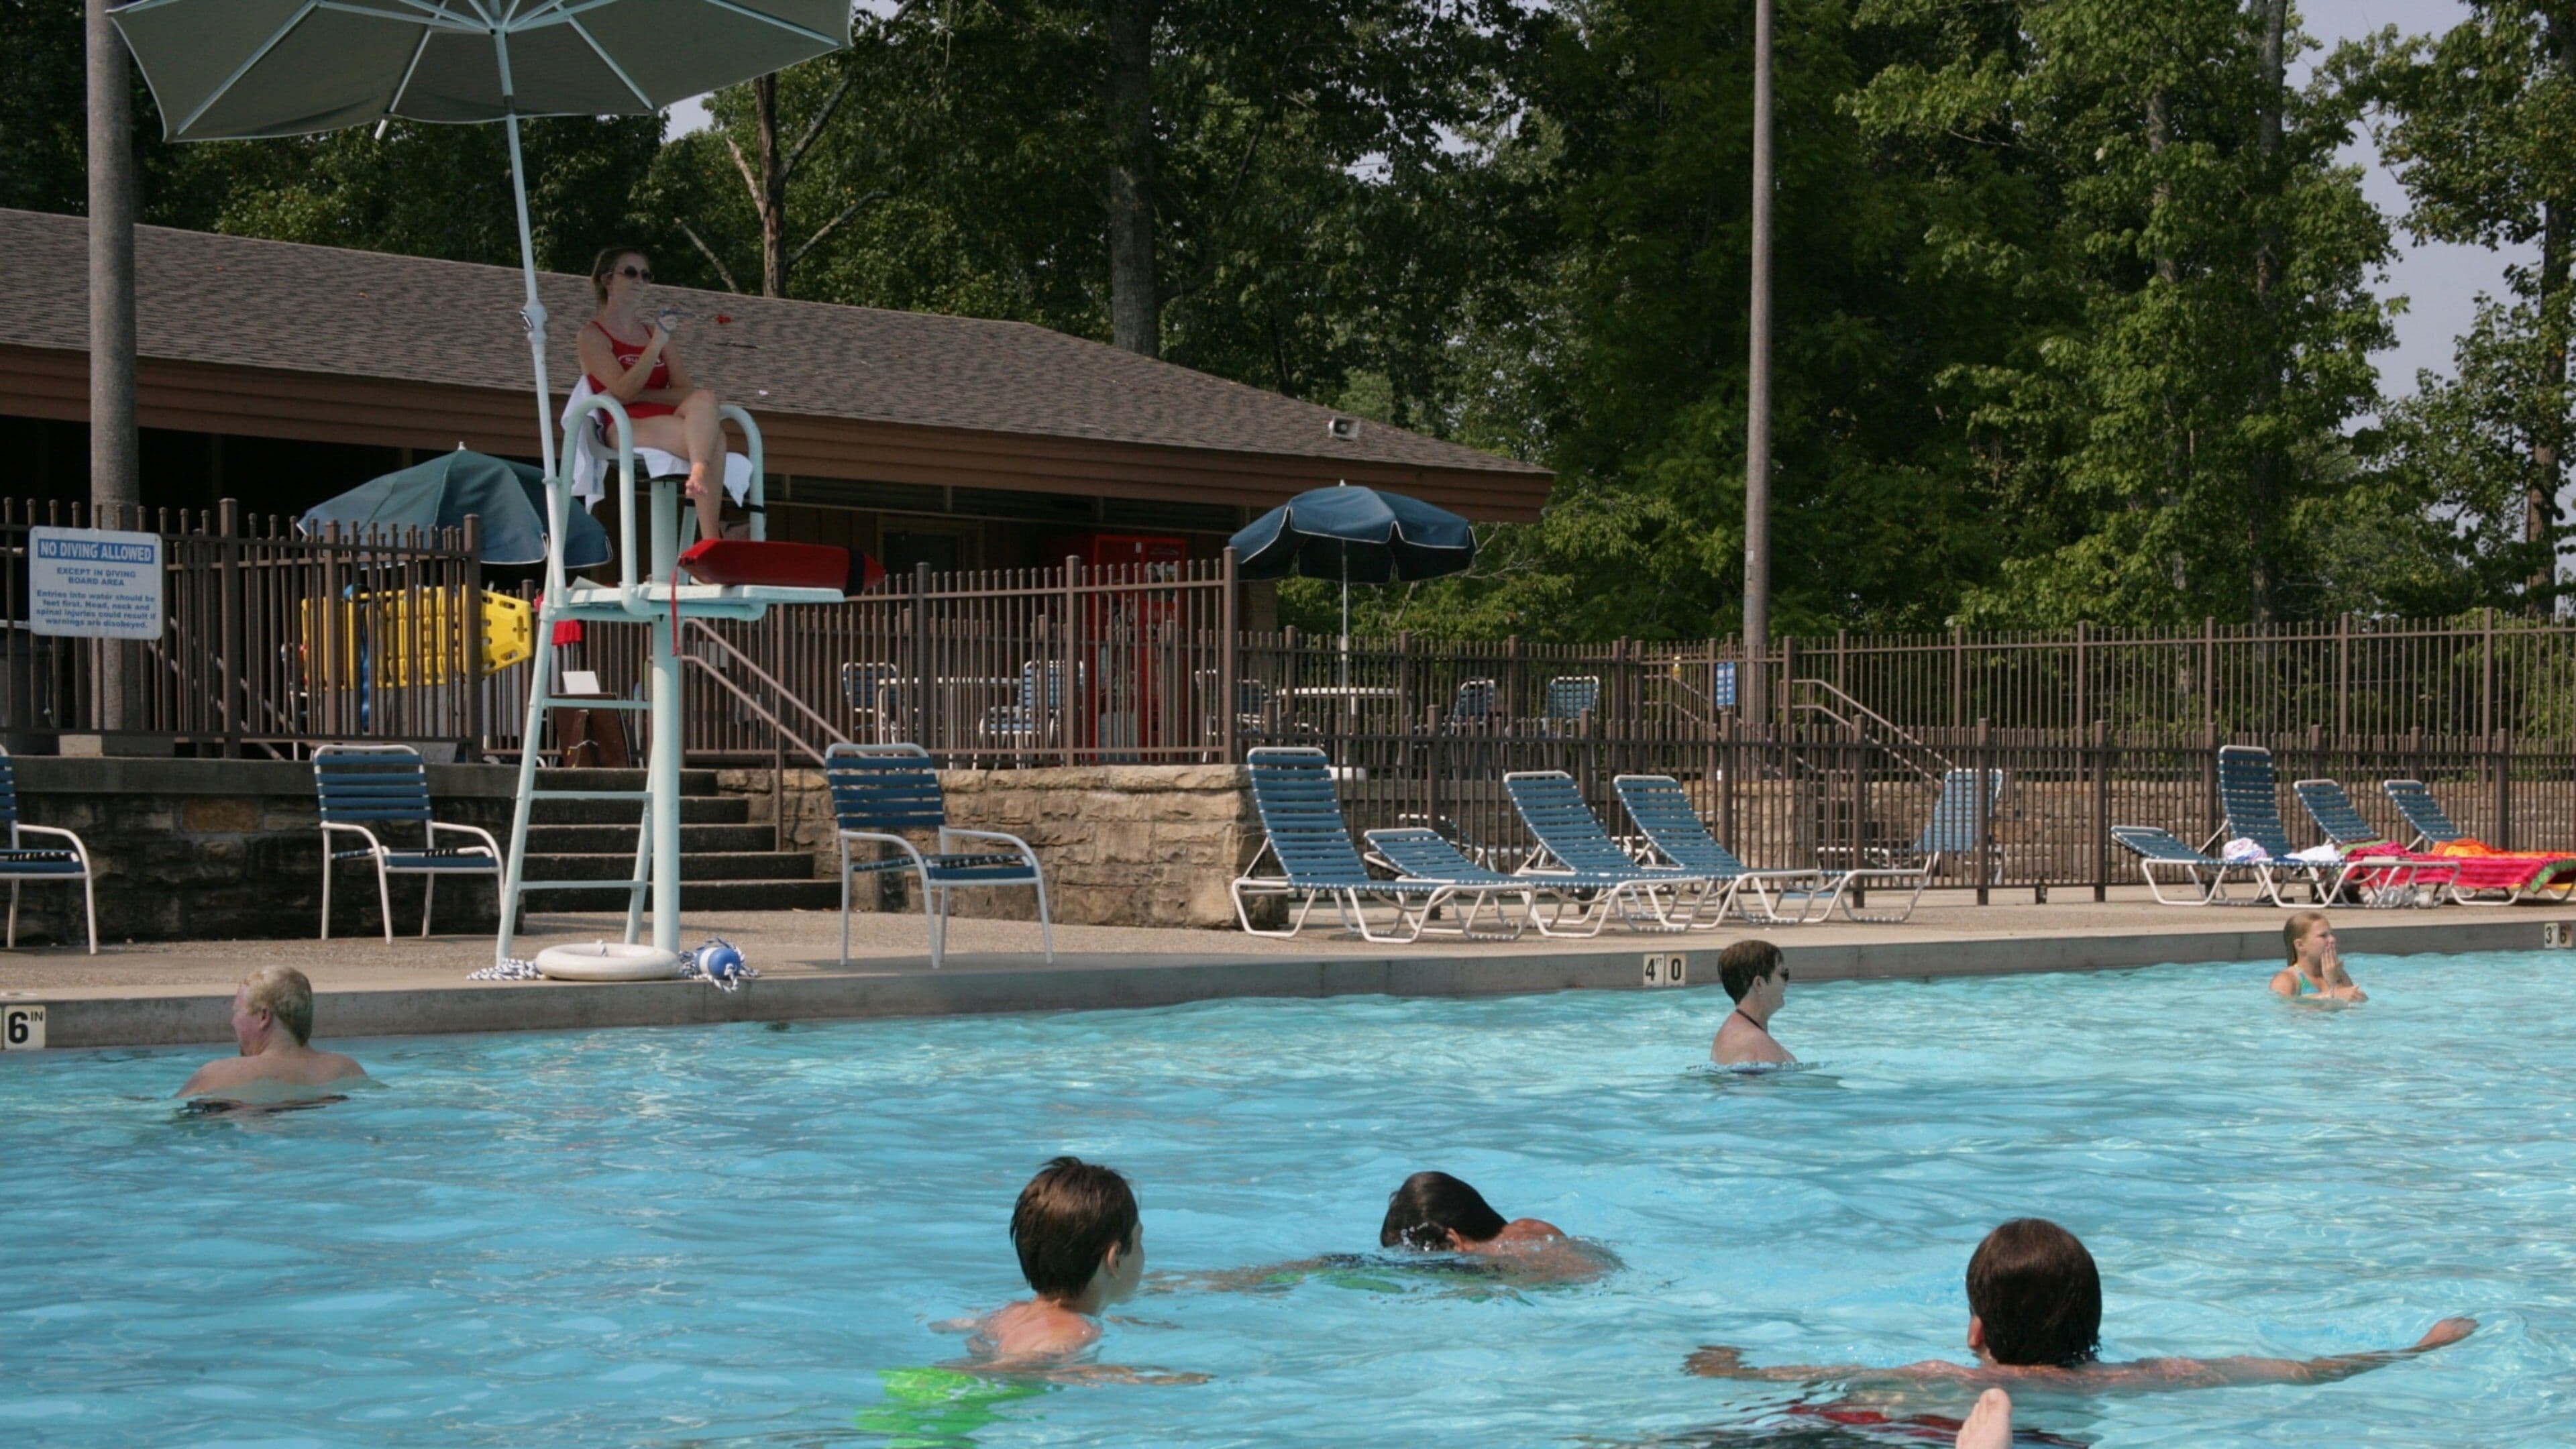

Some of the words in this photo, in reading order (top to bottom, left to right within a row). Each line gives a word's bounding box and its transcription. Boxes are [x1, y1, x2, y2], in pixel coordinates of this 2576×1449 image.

[40, 541, 56, 556] NO
[60, 541, 98, 559] DIVING
[101, 544, 152, 562] ALLOWED
[57, 567, 90, 576] EXCEPT
[93, 568, 103, 576] IN
[106, 570, 136, 578] DIVING
[68, 576, 99, 585] BOARD
[101, 578, 125, 586] AREA
[36, 590, 67, 598] Entries
[115, 594, 143, 602] should
[85, 601, 109, 610] Head,
[36, 608, 62, 616] spinal
[64, 609, 96, 618] injuries
[99, 610, 121, 619] could
[46, 619, 85, 627] warnings
[103, 620, 148, 629] disobeyed.
[2546, 926, 2553, 945] 3
[2559, 925, 2567, 945] 6
[1645, 957, 1656, 981] 4
[1671, 957, 1682, 981] 0
[8, 1011, 29, 1044] 6
[31, 1011, 43, 1021] IN
